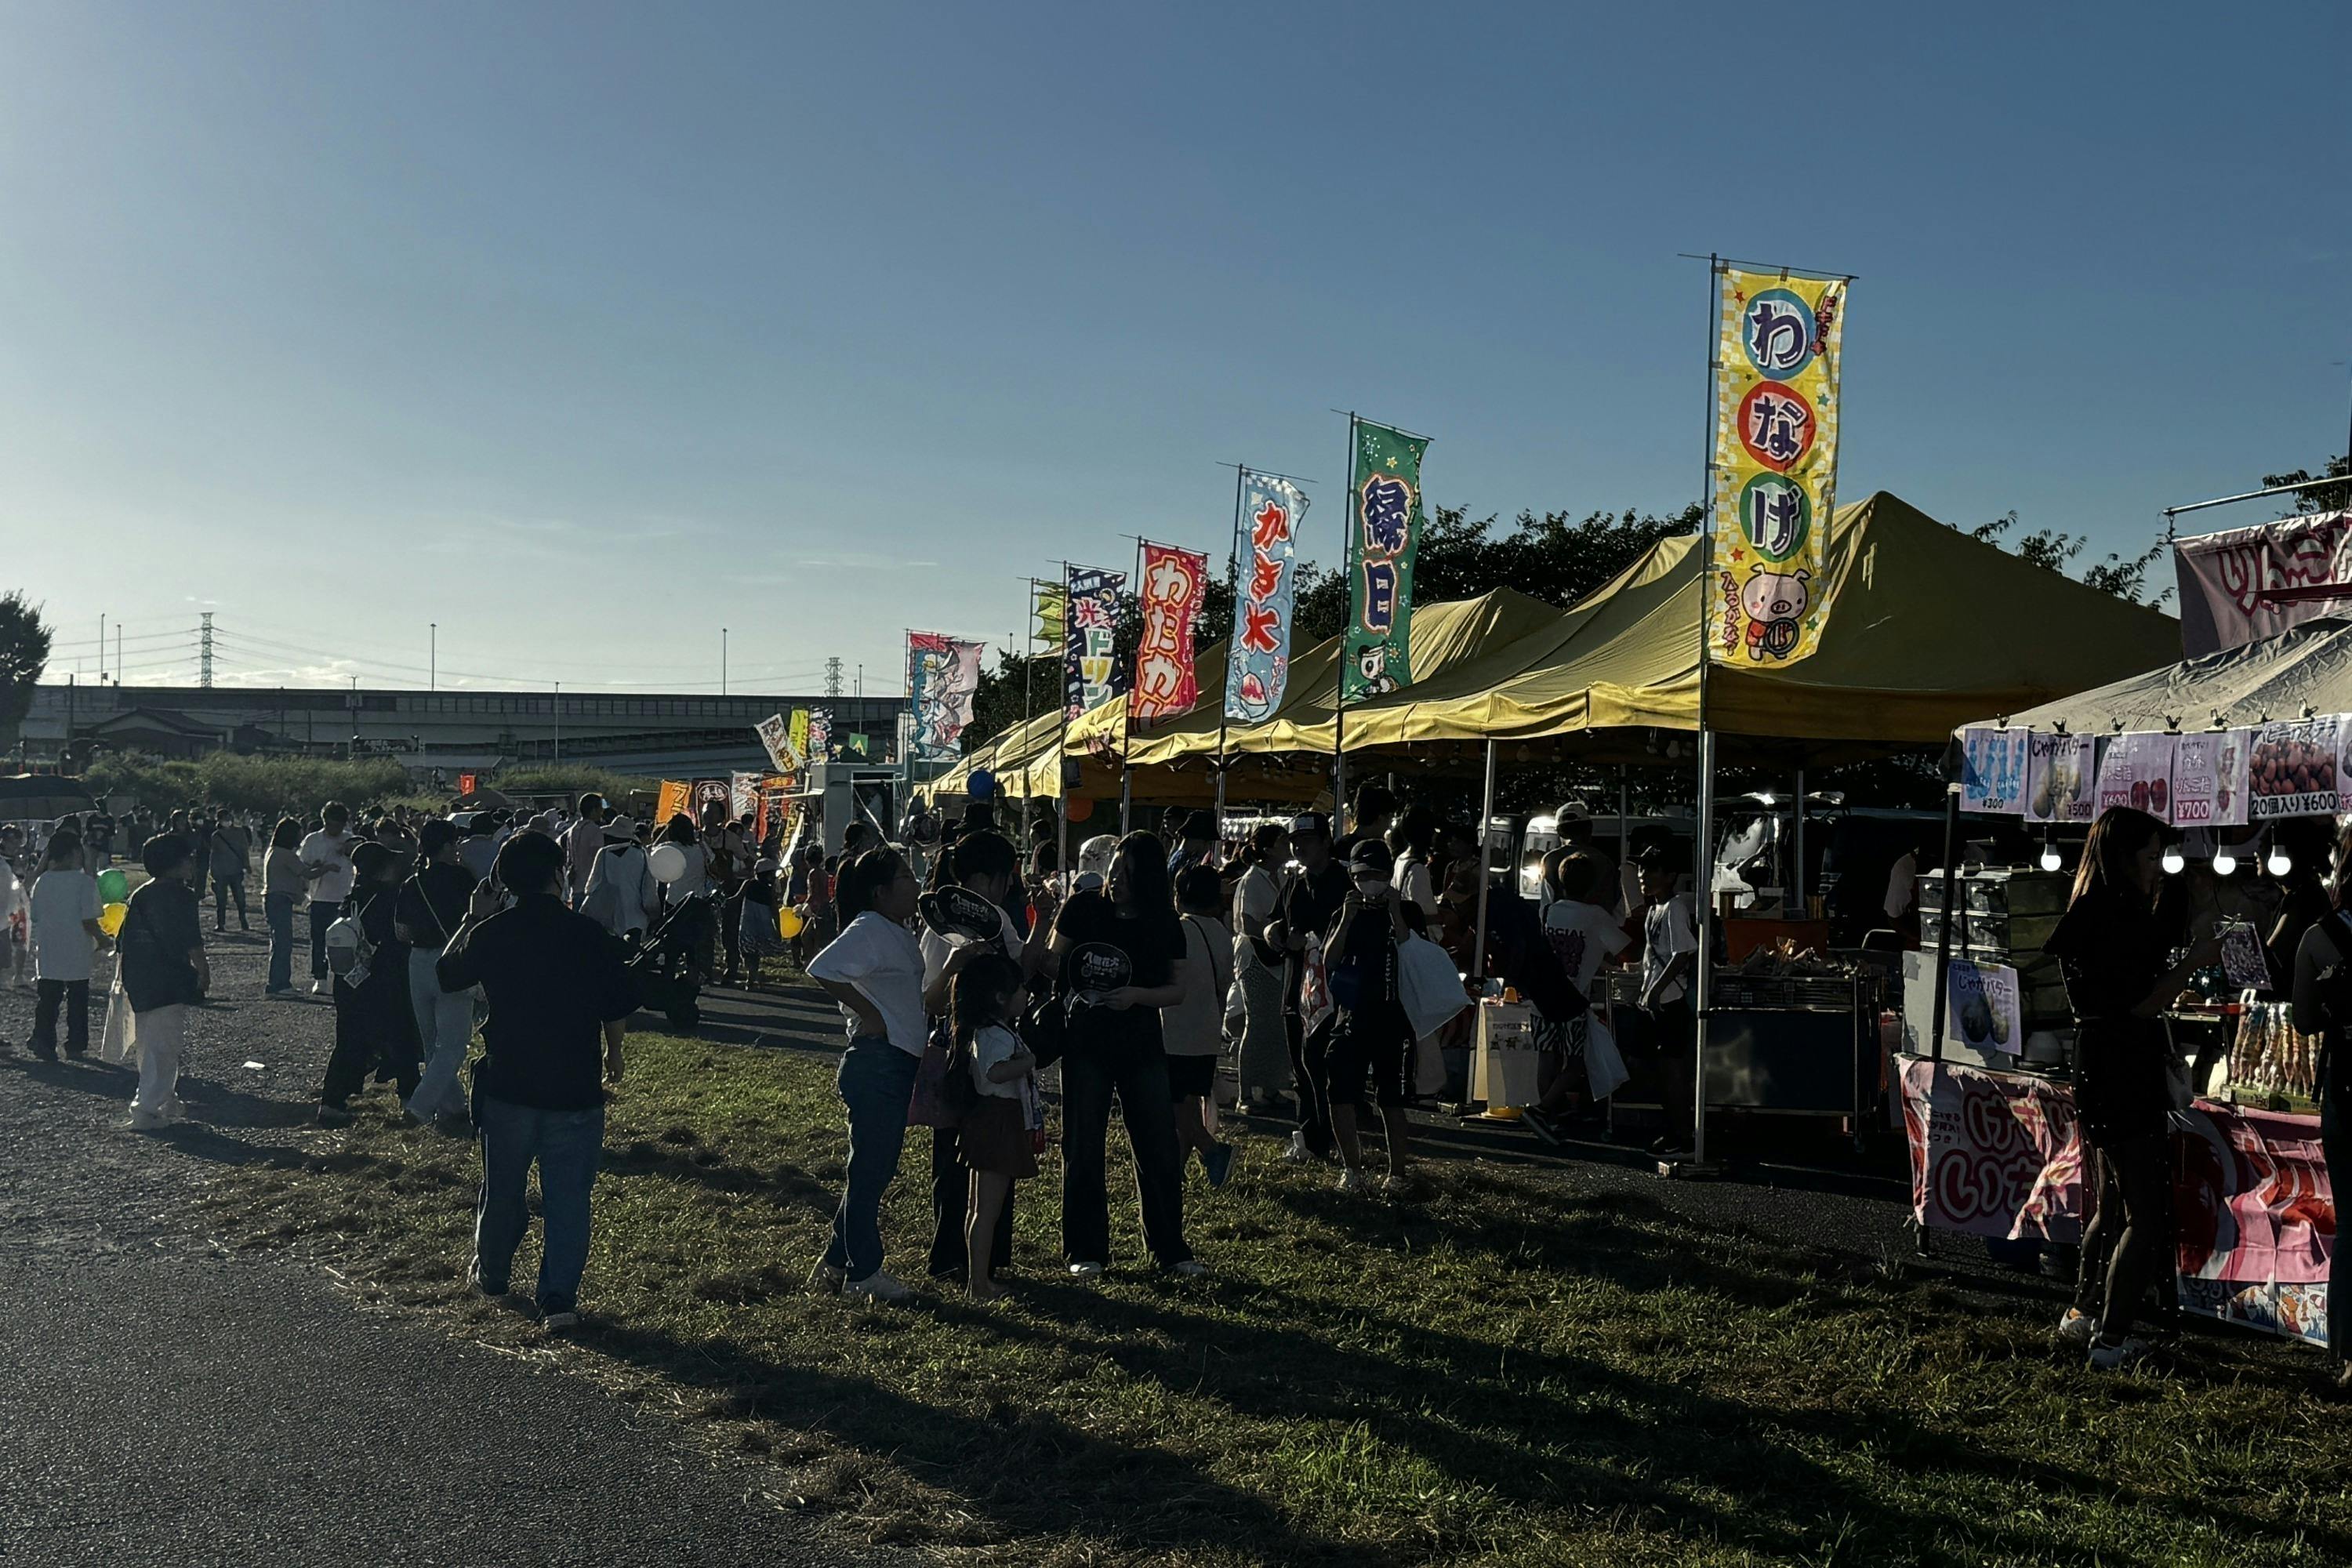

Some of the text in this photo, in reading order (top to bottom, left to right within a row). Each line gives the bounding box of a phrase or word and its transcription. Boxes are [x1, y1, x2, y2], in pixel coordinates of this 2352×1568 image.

[1749, 301, 1808, 555] わなげ
[2177, 801, 2209, 818] ¥700
[2302, 793, 2336, 811] ¥600
[1543, 927, 1585, 939] OCIAL
